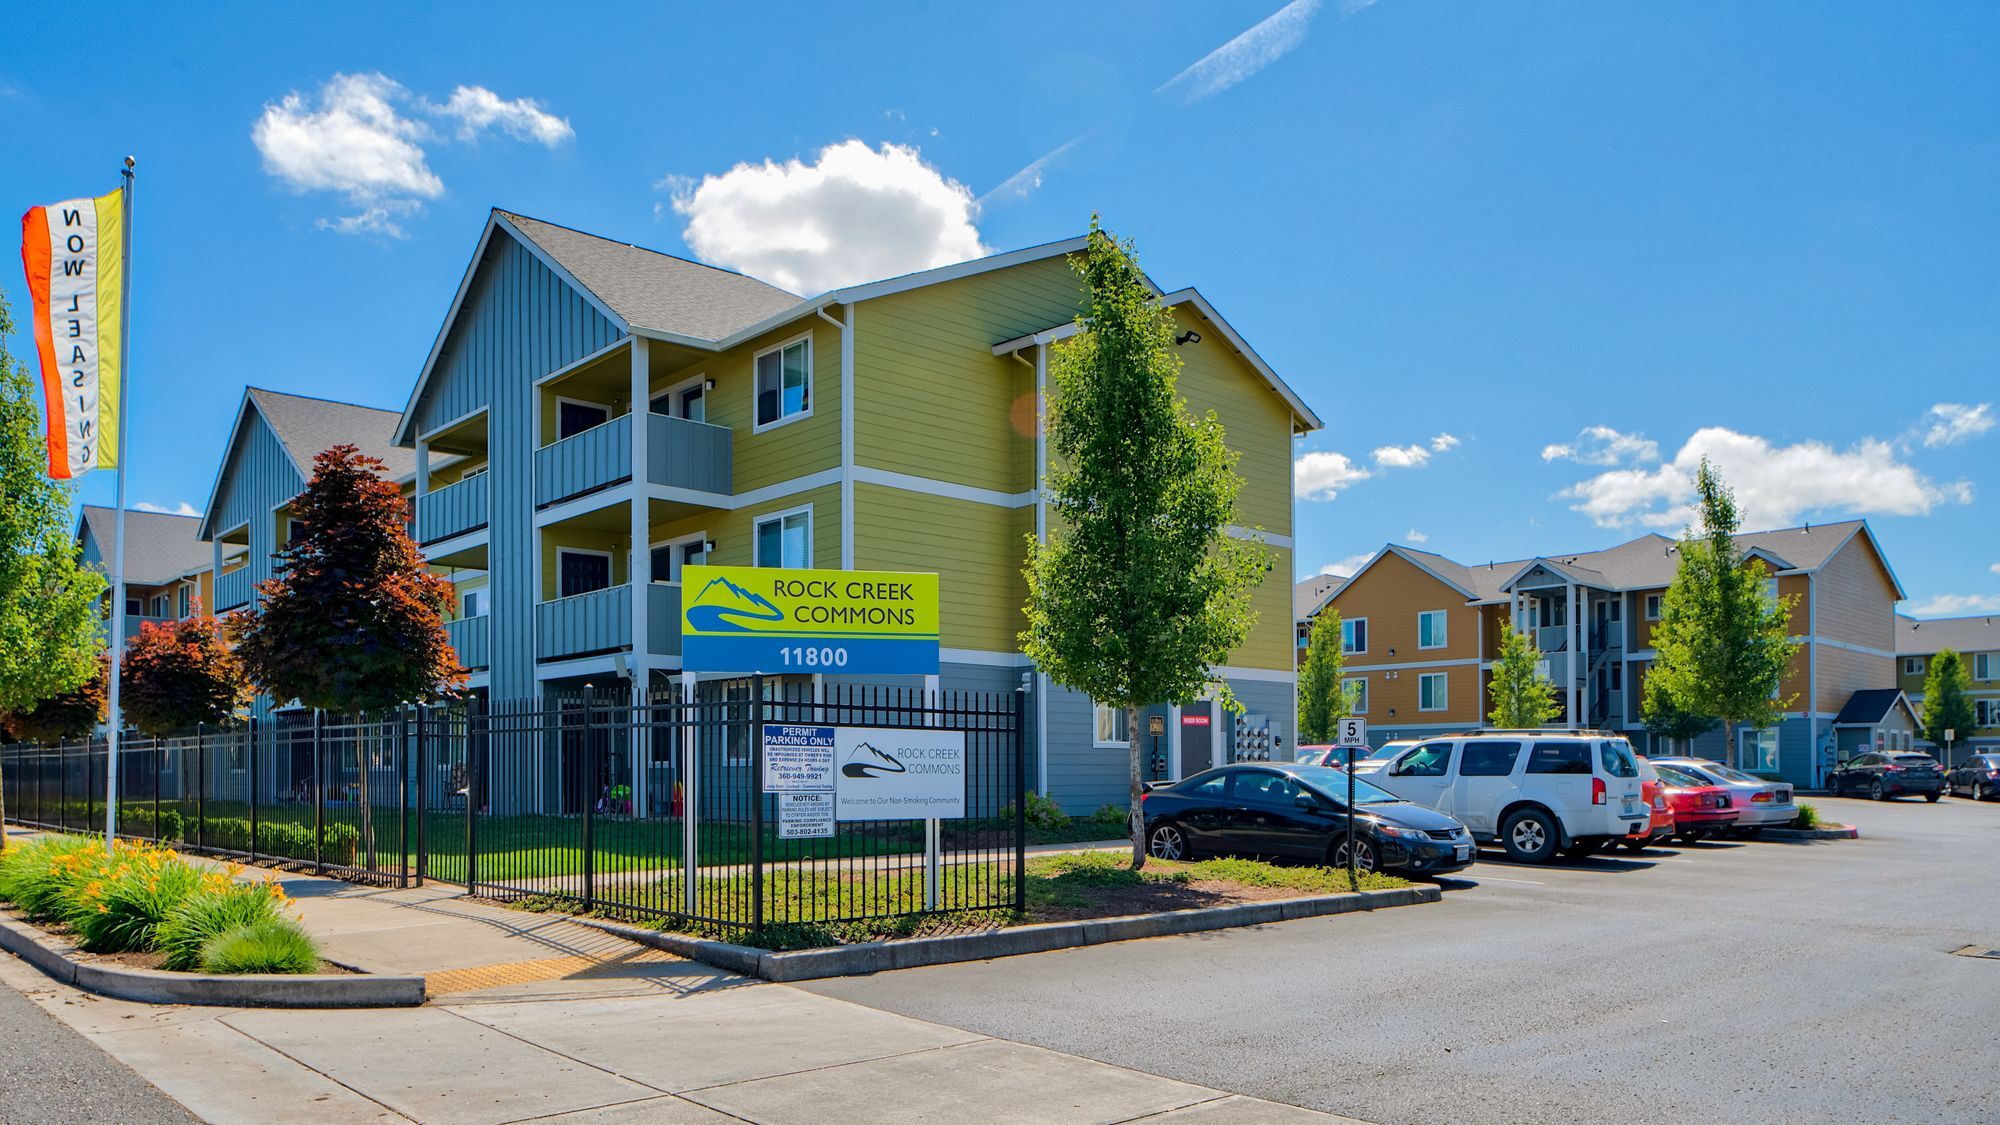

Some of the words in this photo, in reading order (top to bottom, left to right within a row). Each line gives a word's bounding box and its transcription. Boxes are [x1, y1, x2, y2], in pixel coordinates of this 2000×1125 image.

[774, 579, 838, 599] ROCK
[845, 582, 914, 600] CREEK
[794, 605, 915, 626] COMMONS
[779, 646, 848, 667] 11800
[782, 727, 818, 736] PERMIT
[1347, 722, 1356, 736] 5
[765, 736, 808, 745] PARKING
[810, 737, 834, 746] ONLY
[897, 748, 926, 759] ROCK
[928, 748, 960, 760] CREEK
[770, 763, 802, 772] Retriever
[804, 763, 829, 774] Towing
[908, 763, 961, 775] COMMONS
[841, 797, 869, 805] Welcome
[889, 796, 928, 806] Non-Smoking
[928, 796, 960, 805] Community
